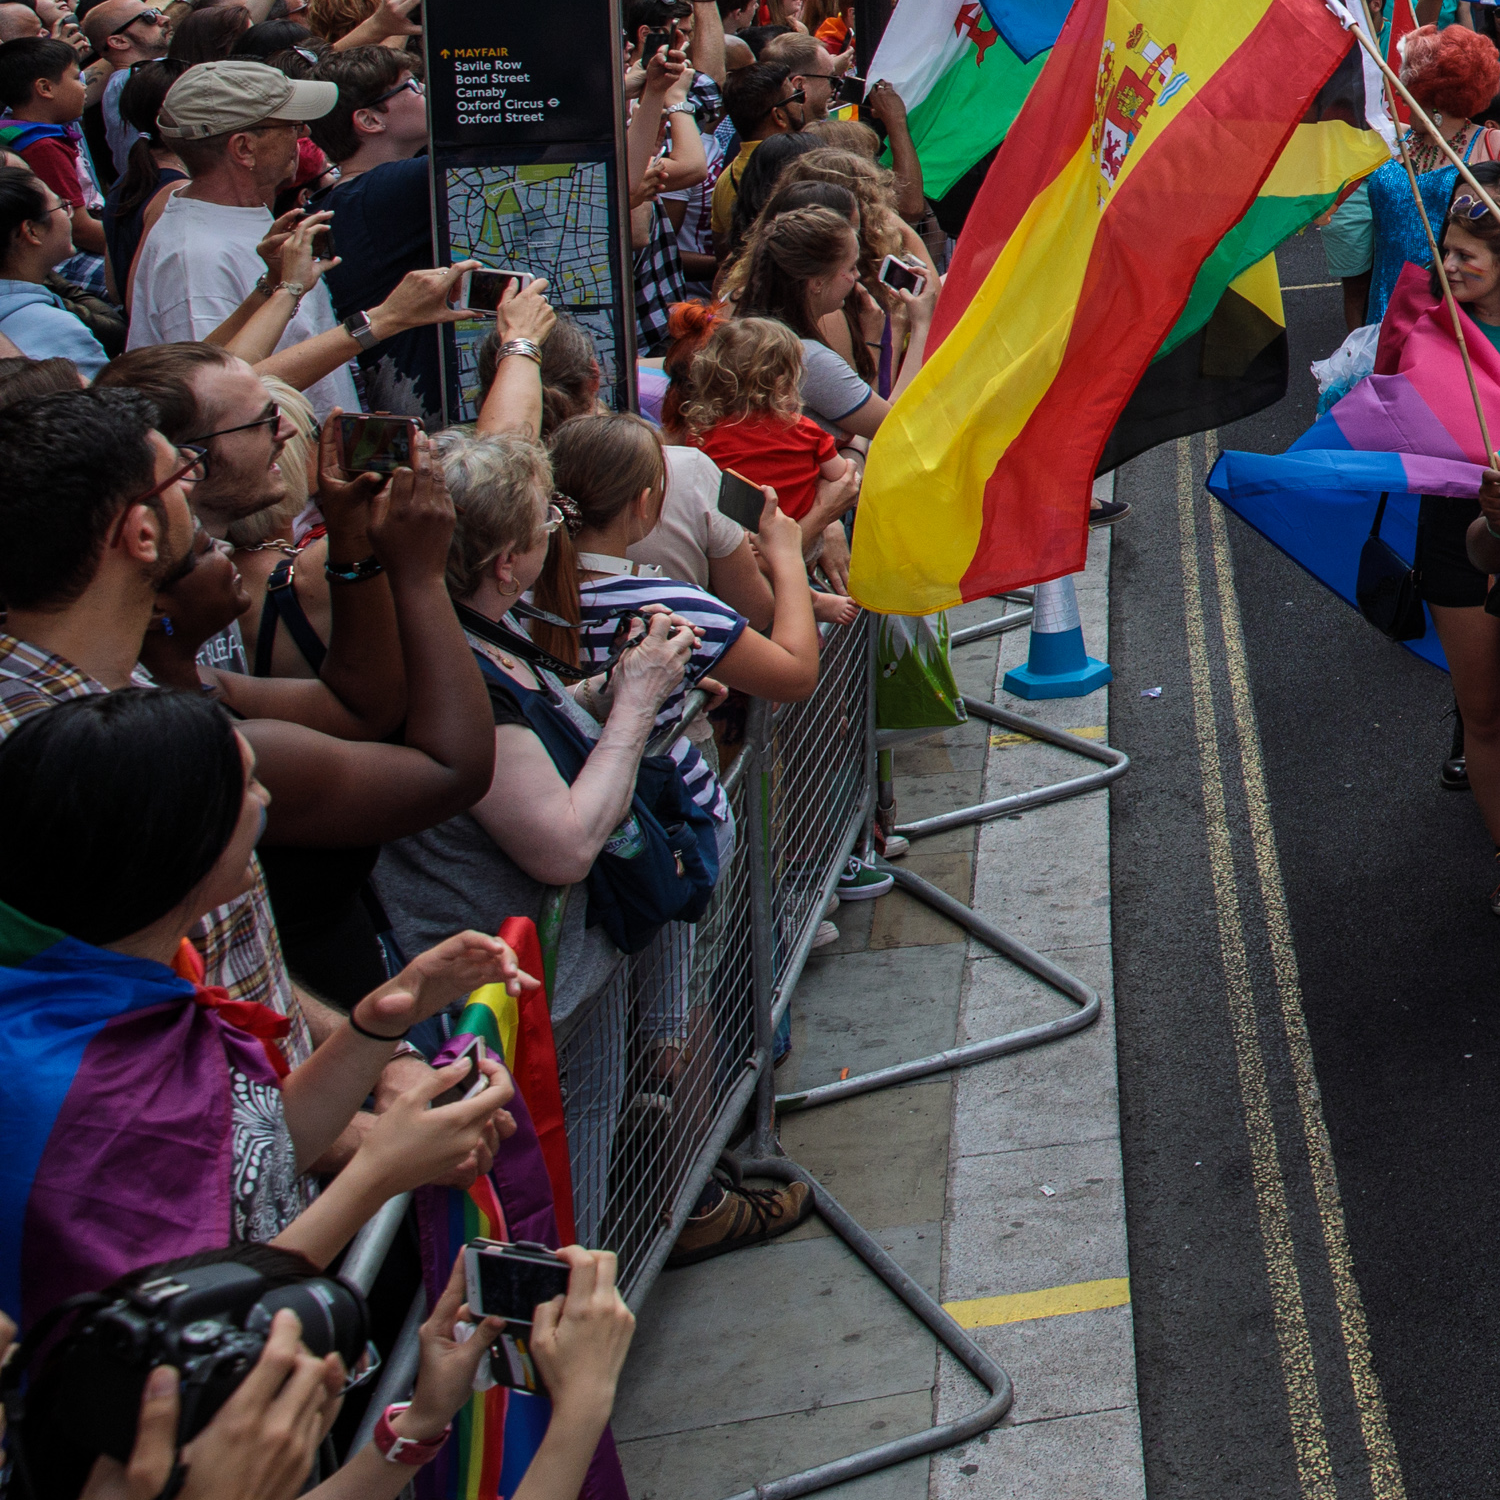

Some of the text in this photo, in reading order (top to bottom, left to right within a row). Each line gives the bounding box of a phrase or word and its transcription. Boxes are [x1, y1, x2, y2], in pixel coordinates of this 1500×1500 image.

[454, 47, 509, 58] MAYFAIR
[454, 60, 523, 72] Savile Row
[455, 73, 531, 84] Bond Street
[456, 86, 507, 99] Carnaby
[456, 99, 544, 111] Oxford Circus
[457, 112, 545, 124] Oxford Street
